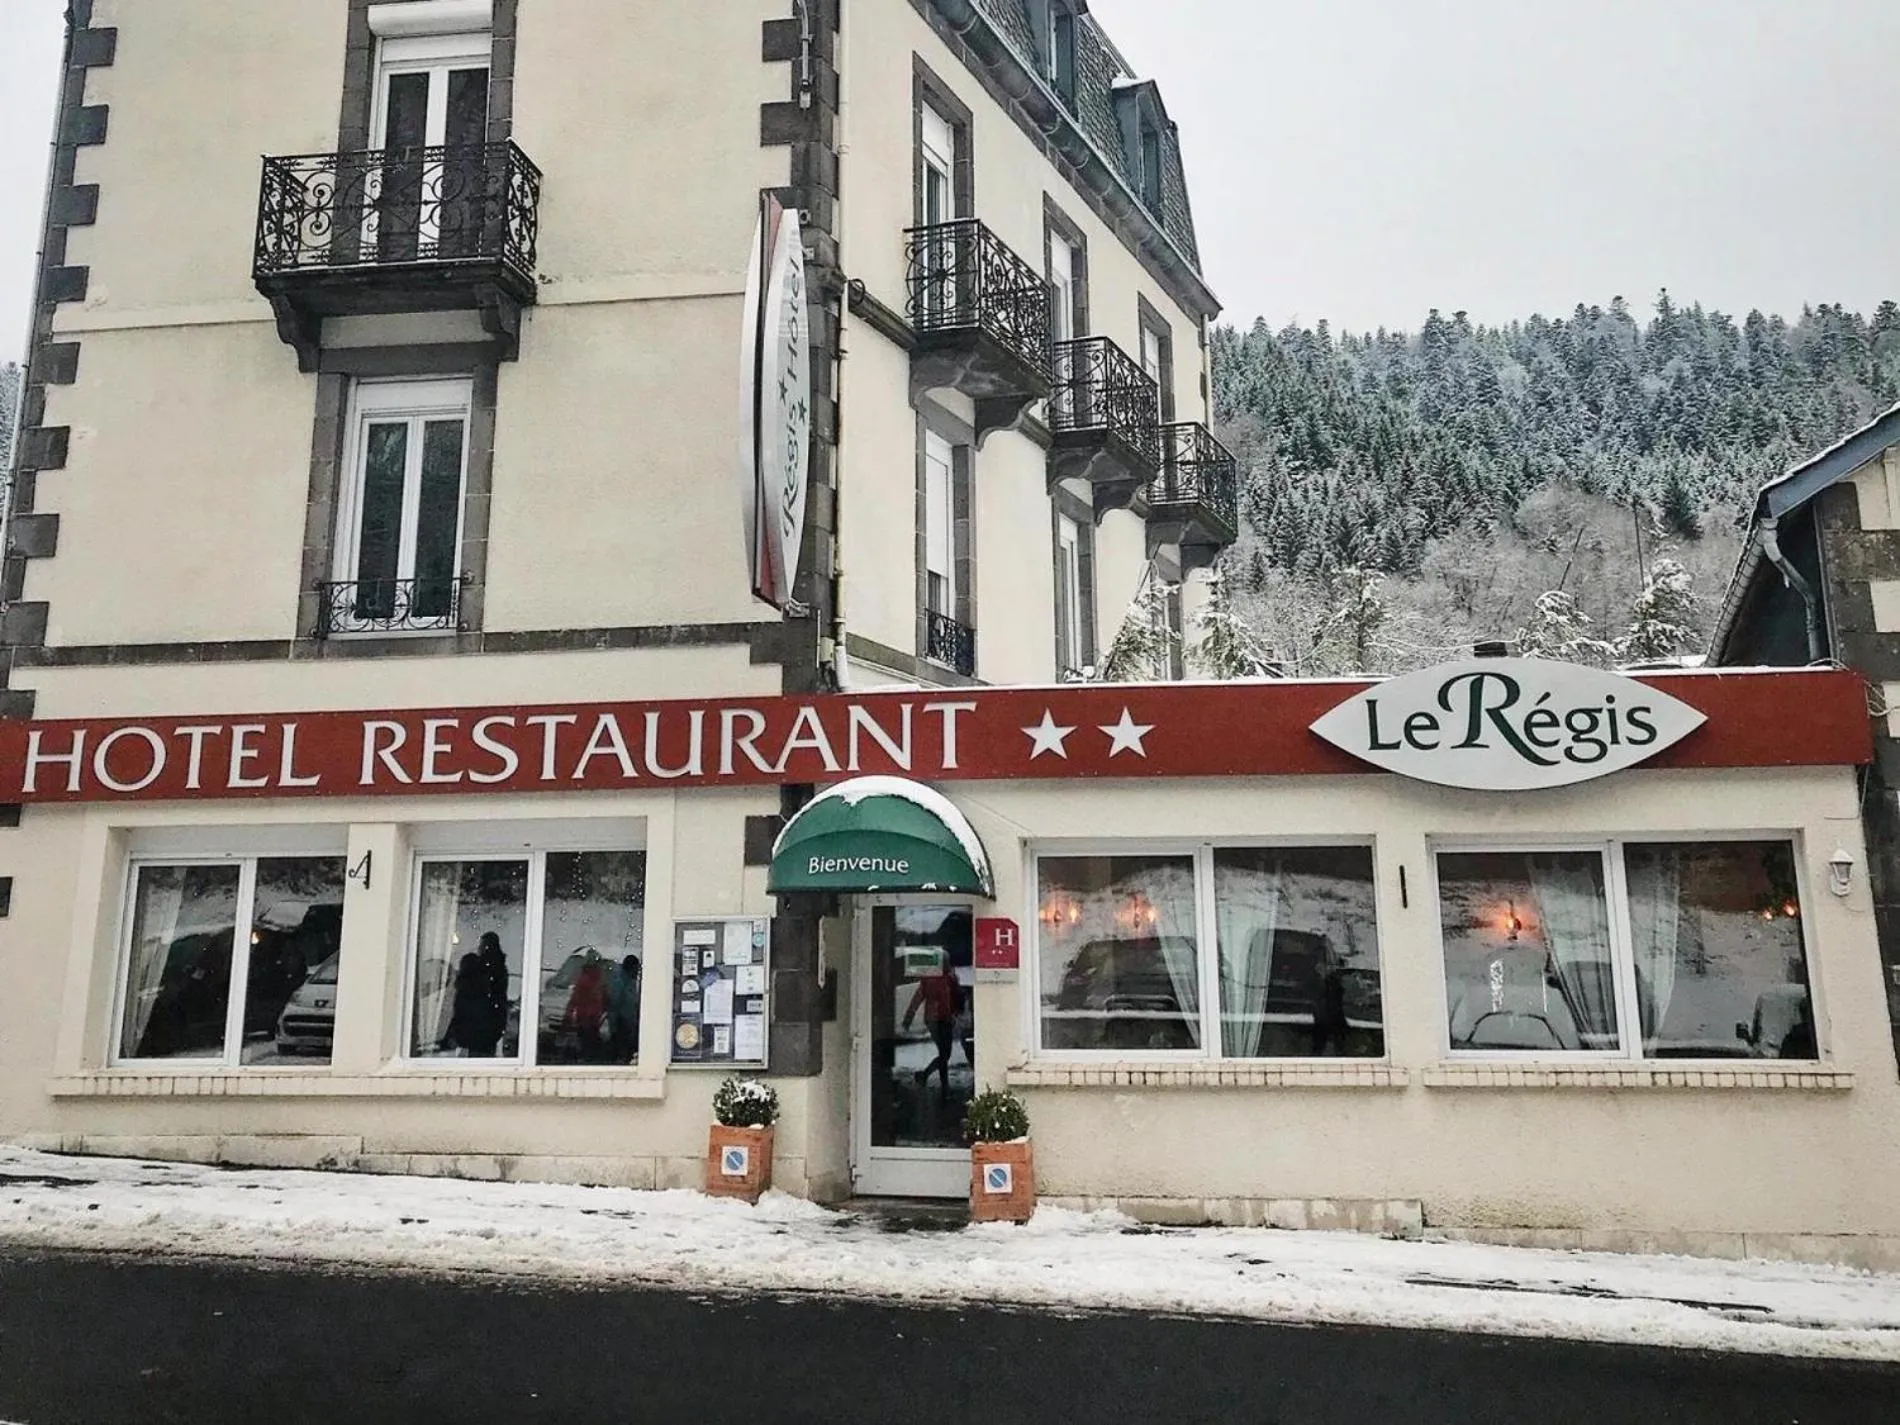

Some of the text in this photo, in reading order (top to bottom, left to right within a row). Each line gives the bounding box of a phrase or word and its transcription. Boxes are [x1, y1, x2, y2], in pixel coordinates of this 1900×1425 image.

[1365, 671, 1658, 766] Le Régis
[21, 701, 977, 793] HOTEL RESTAURANT
[808, 856, 909, 874] Bienvenue
[995, 927, 1014, 947] H
